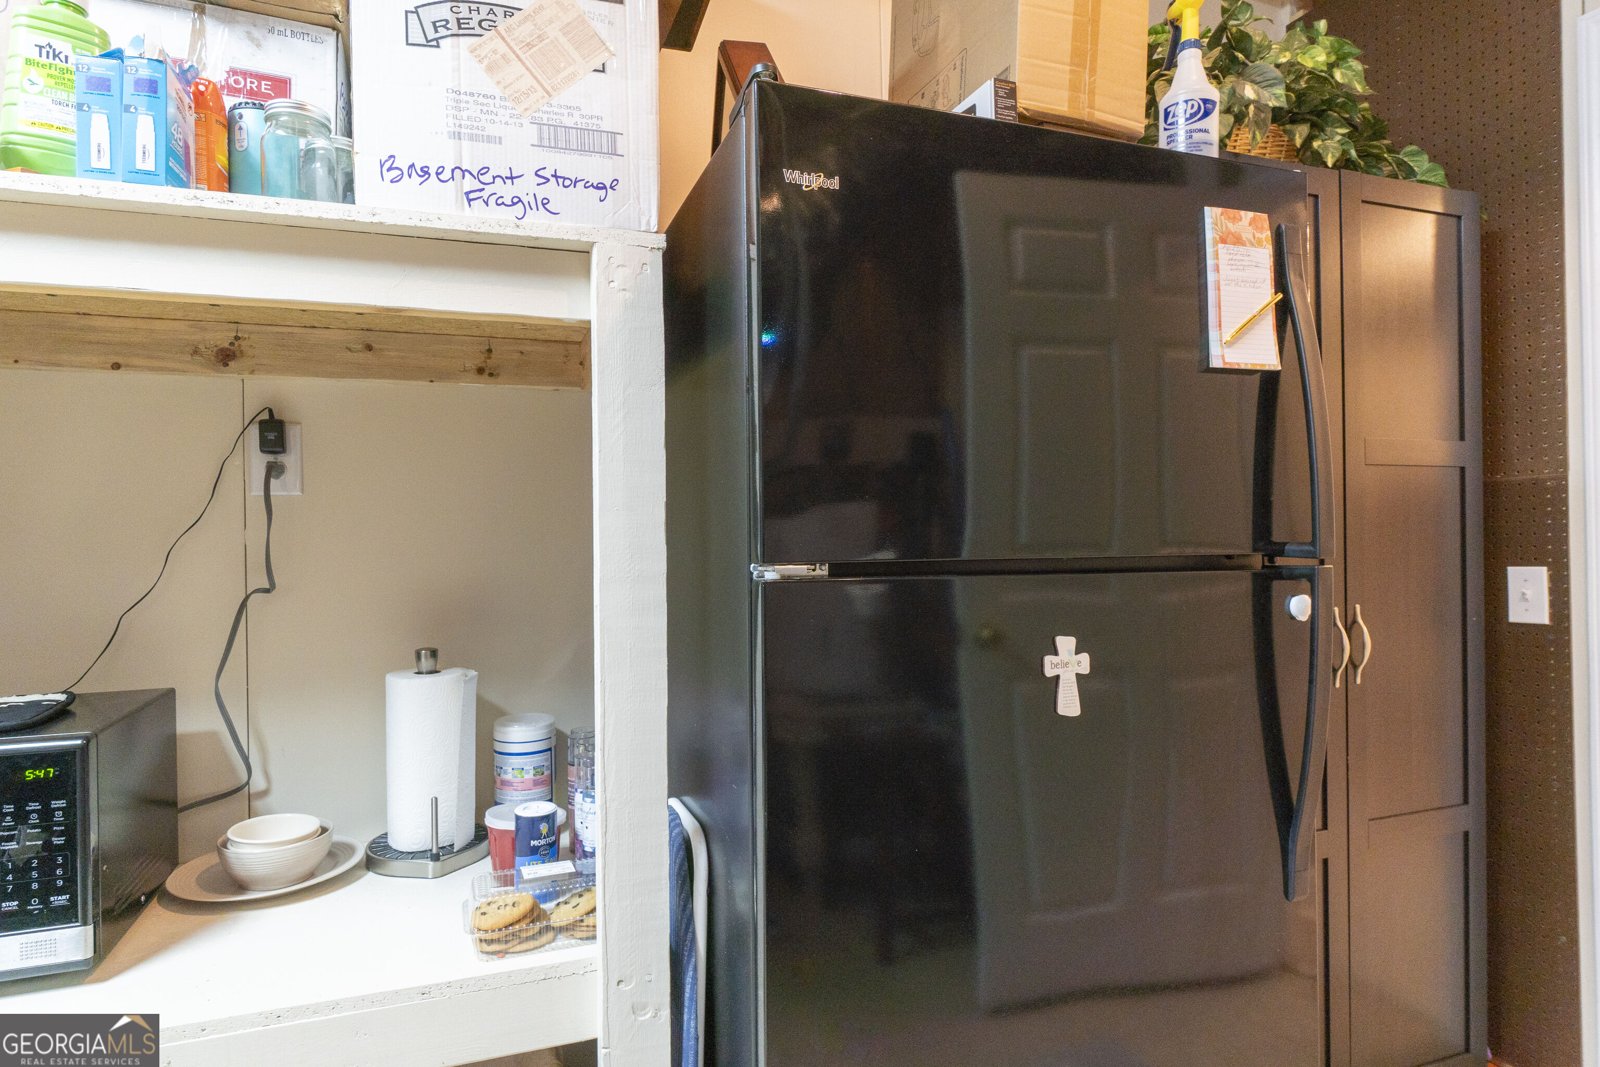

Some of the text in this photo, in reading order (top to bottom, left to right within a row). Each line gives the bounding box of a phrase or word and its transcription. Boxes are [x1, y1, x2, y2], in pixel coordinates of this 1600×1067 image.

[277, 29, 288, 38] mL
[127, 66, 137, 74] 12
[446, 88, 496, 100] D048760
[51, 99, 69, 108] TORCH
[473, 99, 491, 107] Sec
[129, 105, 136, 113] 4
[446, 113, 482, 123] FILLED
[379, 154, 620, 202] Basement Storage
[782, 168, 840, 190] Whirlpool
[464, 187, 561, 220] Fragile
[1050, 658, 1082, 670] believe
[25, 767, 54, 780] 5:47
[530, 835, 556, 847] MORTON
[31, 859, 38, 867] 2
[56, 856, 63, 864] 3
[31, 870, 38, 878] 5
[56, 868, 63, 876] 6
[31, 882, 39, 890] 8
[56, 879, 63, 887] 9
[31, 897, 39, 905] 0
[49, 894, 71, 902] START
